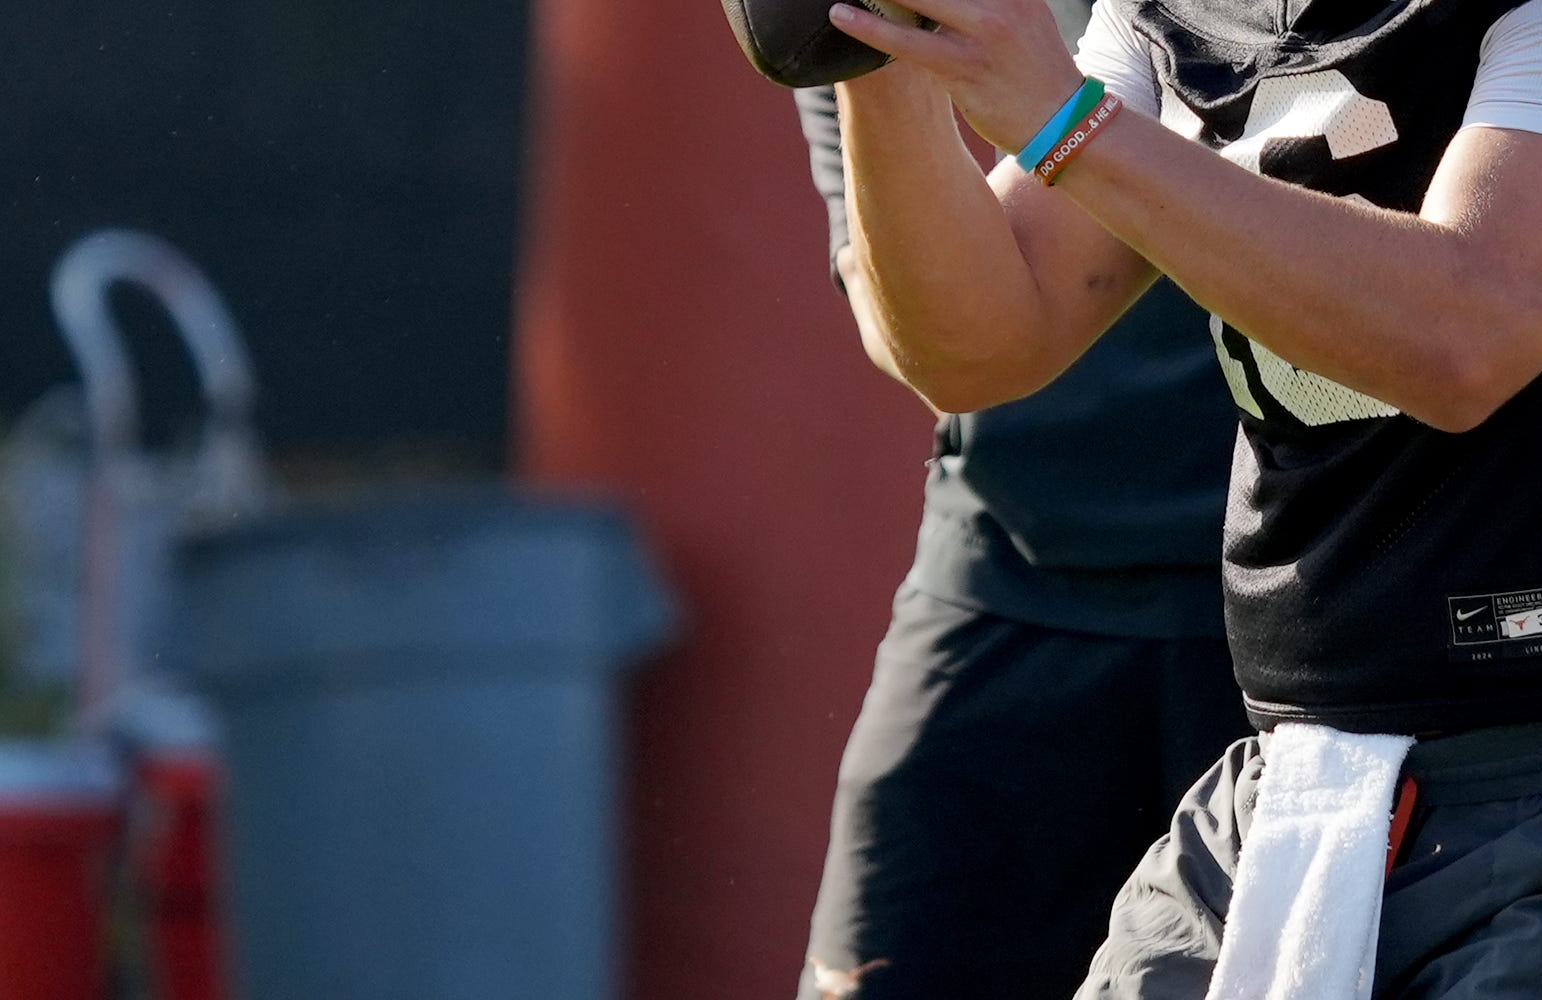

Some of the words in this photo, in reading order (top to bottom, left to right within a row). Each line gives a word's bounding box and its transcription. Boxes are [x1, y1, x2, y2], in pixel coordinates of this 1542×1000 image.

[1039, 160, 1054, 176] DO
[1095, 106, 1110, 122] HE
[1458, 624, 1494, 634] TEAM
